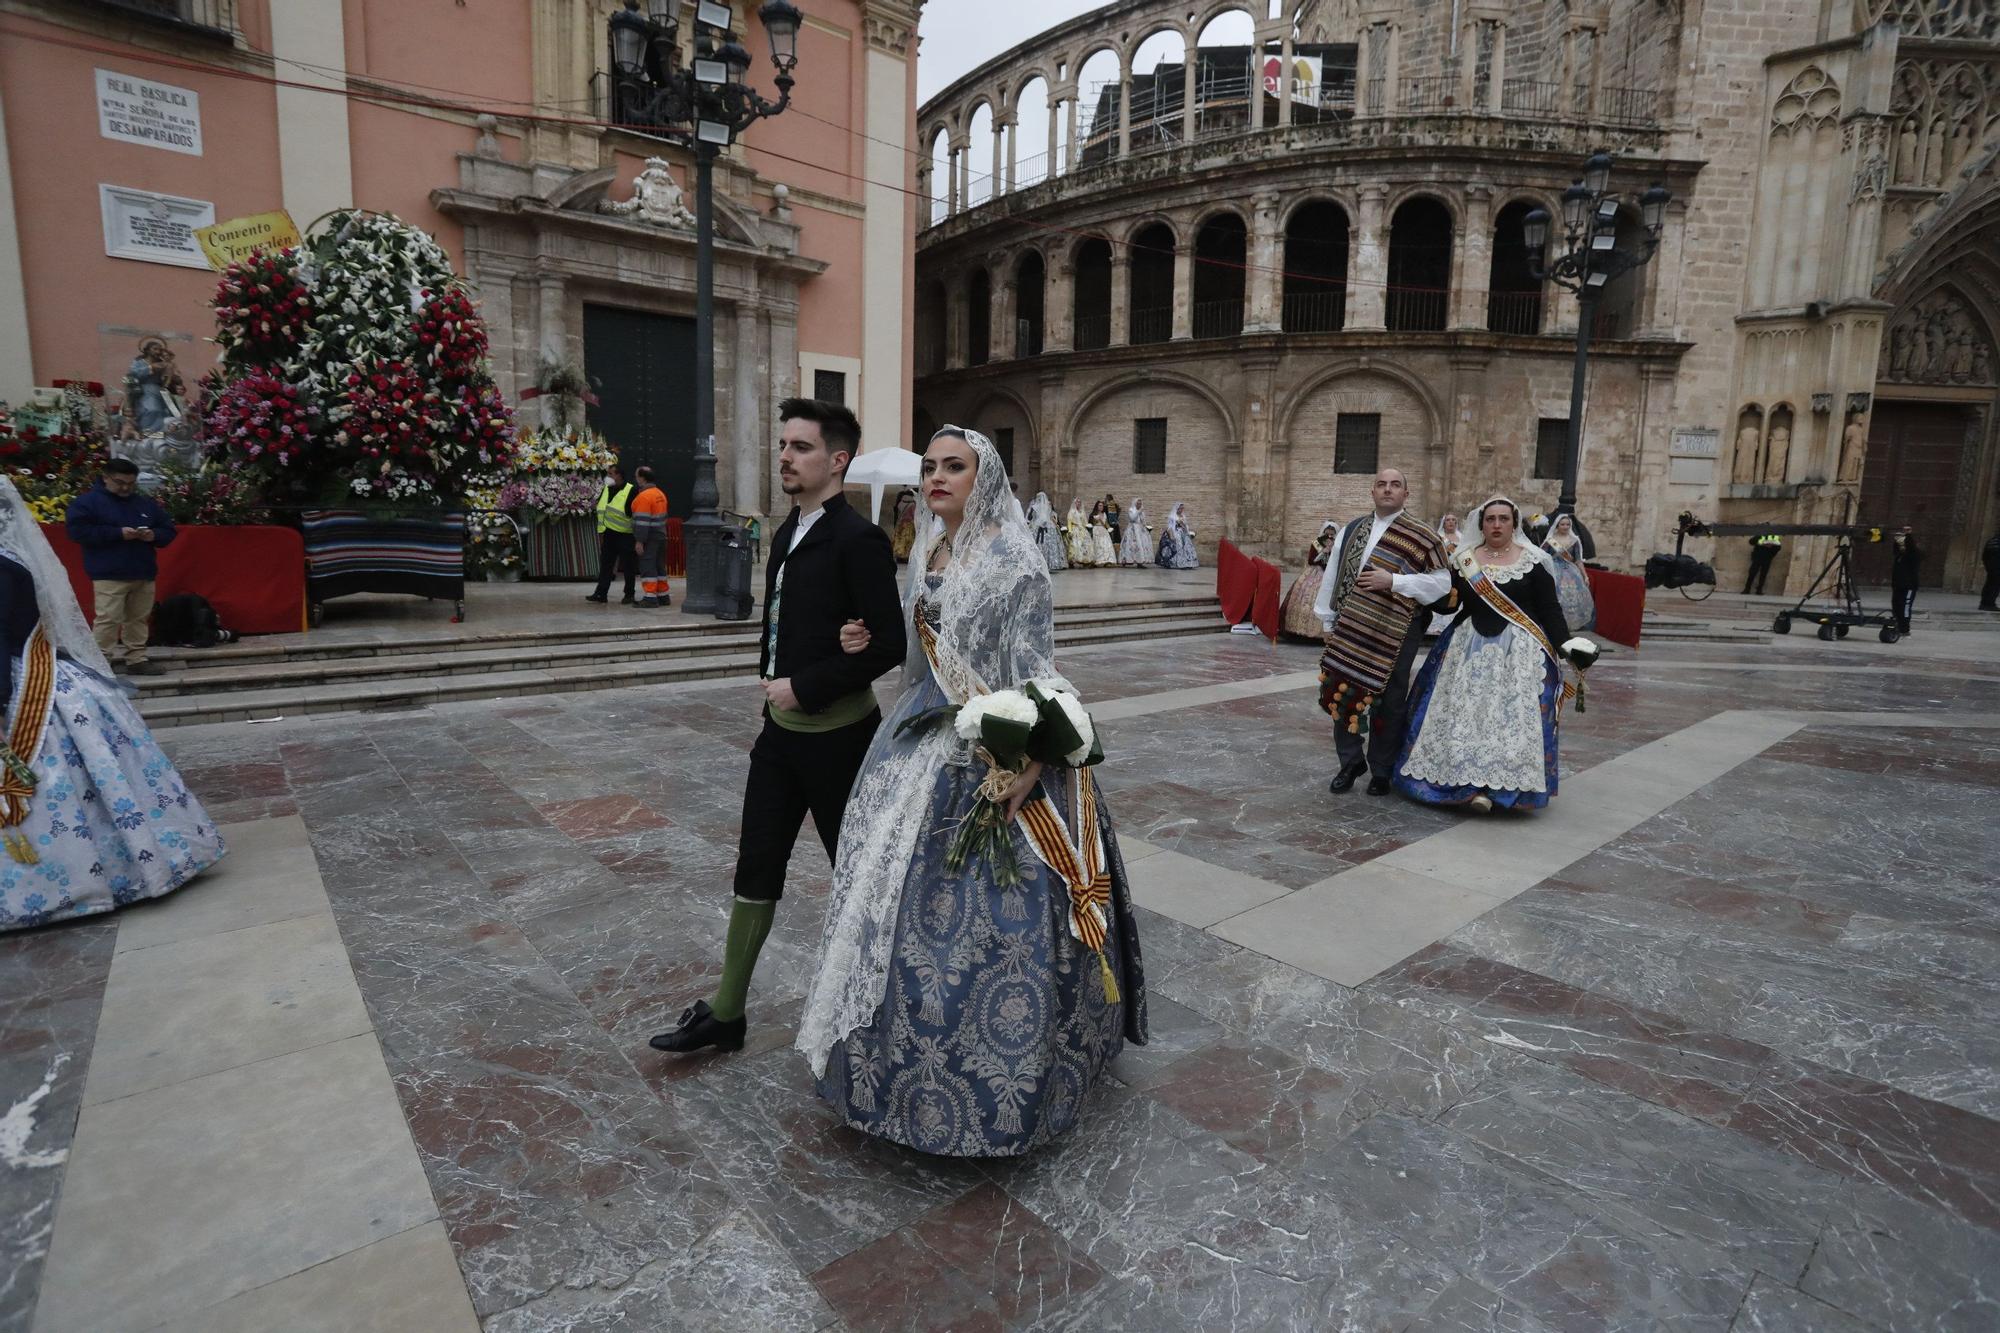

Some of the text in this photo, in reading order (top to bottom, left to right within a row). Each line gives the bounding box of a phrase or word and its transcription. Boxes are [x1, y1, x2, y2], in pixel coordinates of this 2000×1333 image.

[107, 78, 188, 107] REAL BASILICA
[129, 104, 165, 120] SEÑORA
[168, 115, 178, 123] DE
[109, 120, 194, 148] DESAMPARADOS
[208, 223, 272, 248] Convento
